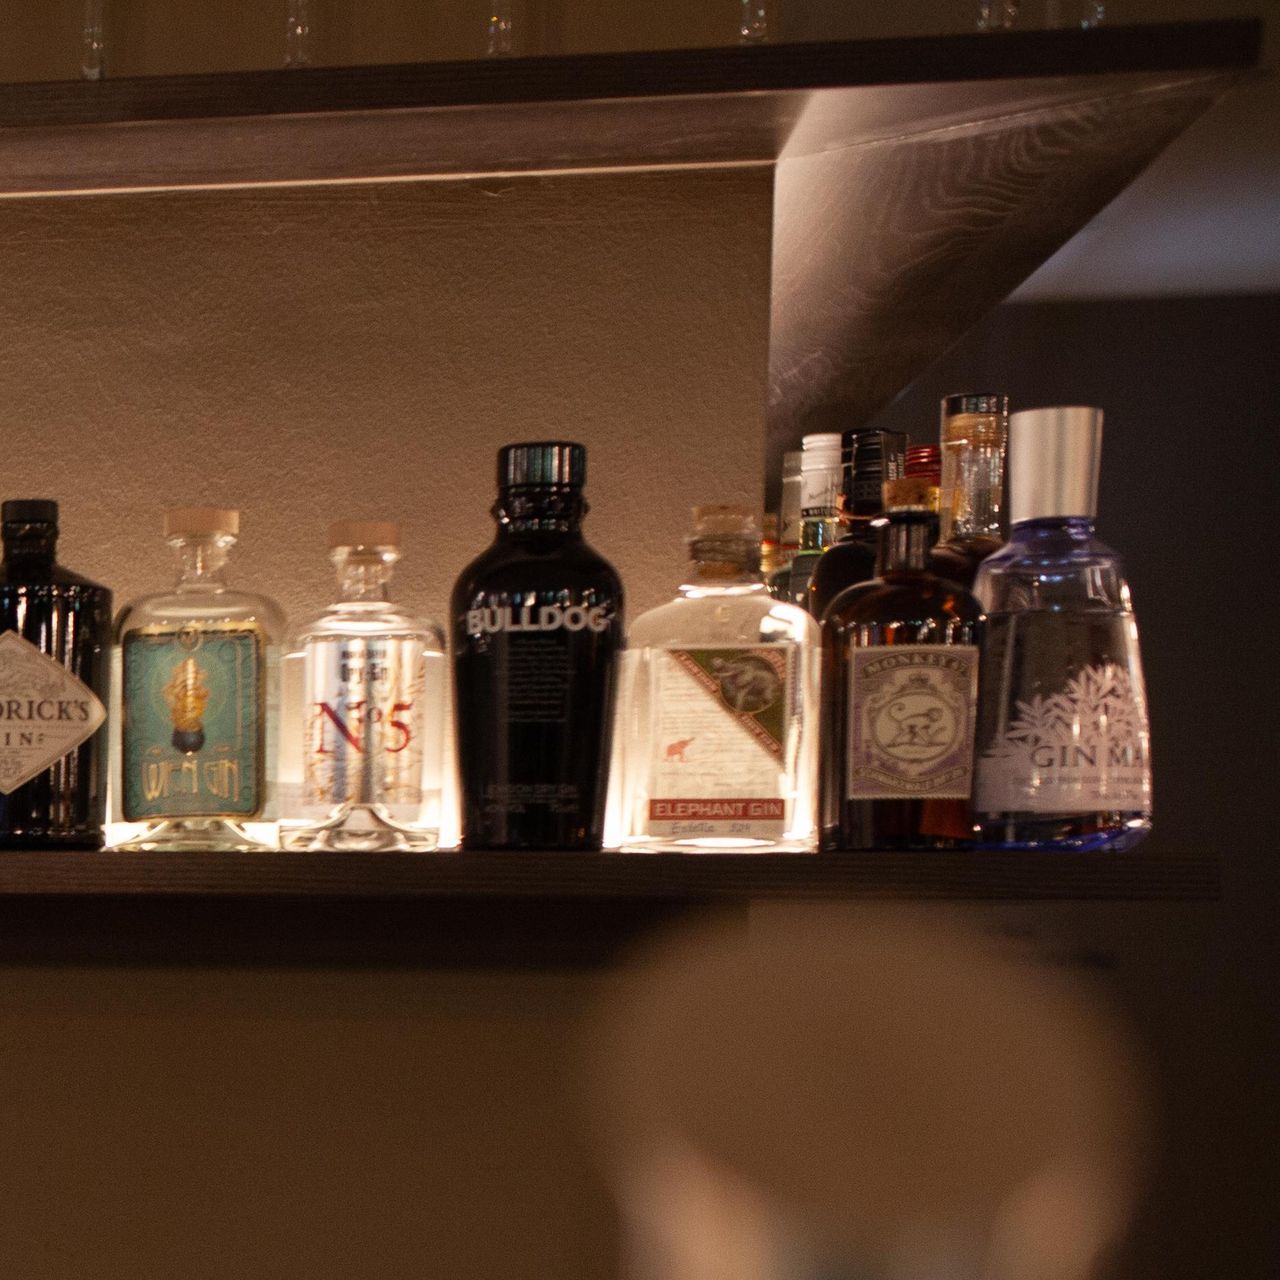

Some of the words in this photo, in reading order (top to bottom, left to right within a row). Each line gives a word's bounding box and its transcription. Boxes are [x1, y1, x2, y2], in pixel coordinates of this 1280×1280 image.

[466, 604, 608, 635] BULLDOG
[1031, 745, 1097, 768] GIN
[655, 802, 746, 817] ELEPHANT
[750, 802, 781, 816] GIN
